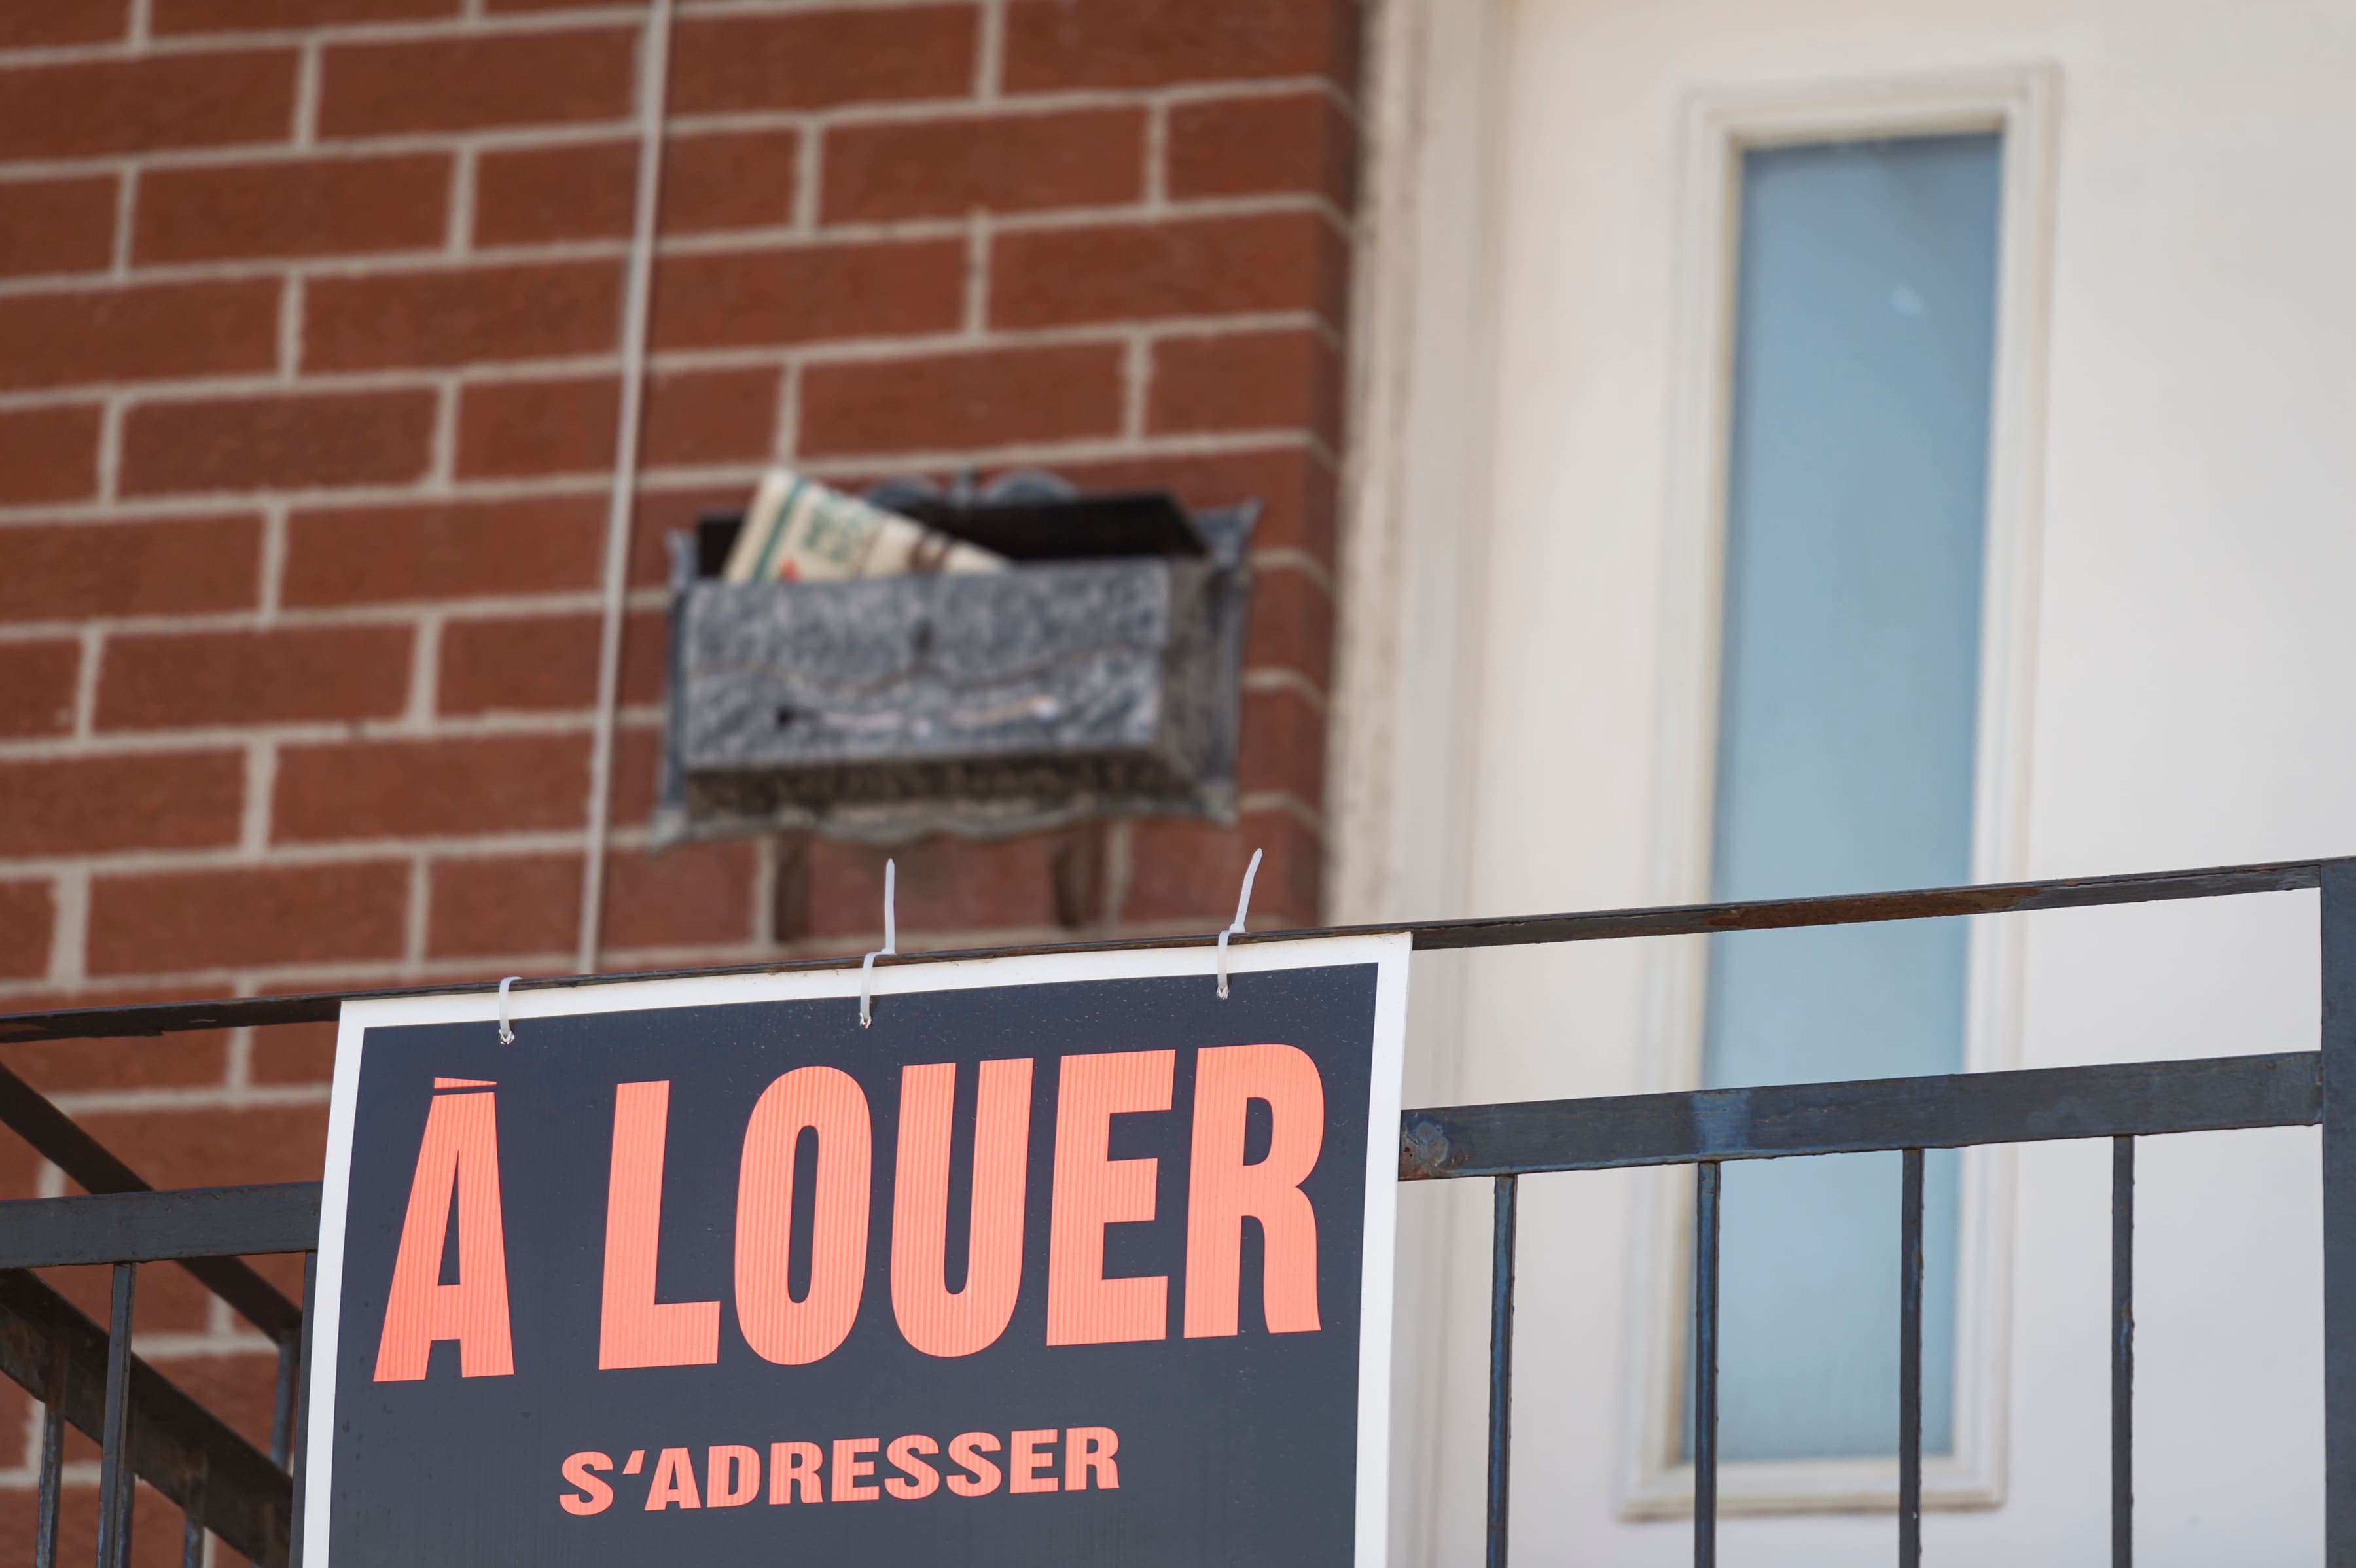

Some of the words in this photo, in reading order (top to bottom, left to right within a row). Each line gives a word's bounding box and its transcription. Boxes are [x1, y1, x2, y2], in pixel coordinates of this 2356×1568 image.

[372, 1077, 515, 1382] À
[598, 1044, 1325, 1370] LOUER
[559, 1426, 1120, 1516] S'ADRESSER
